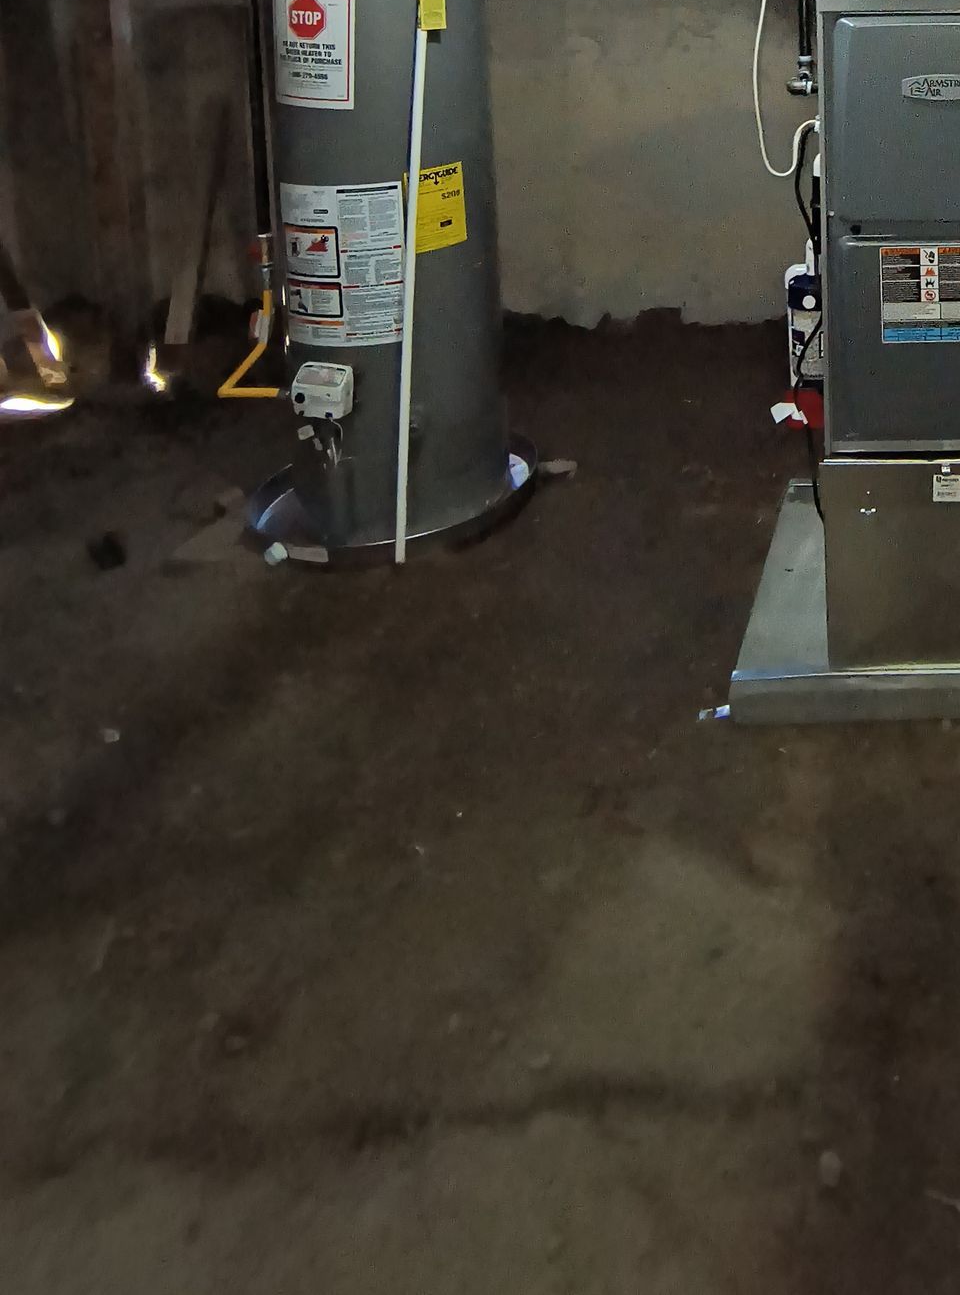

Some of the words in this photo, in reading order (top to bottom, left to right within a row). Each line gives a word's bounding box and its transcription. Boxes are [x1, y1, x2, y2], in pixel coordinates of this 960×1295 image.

[291, 10, 322, 26] STOP
[310, 57, 342, 65] PURCHASE
[925, 87, 942, 97] AIR
